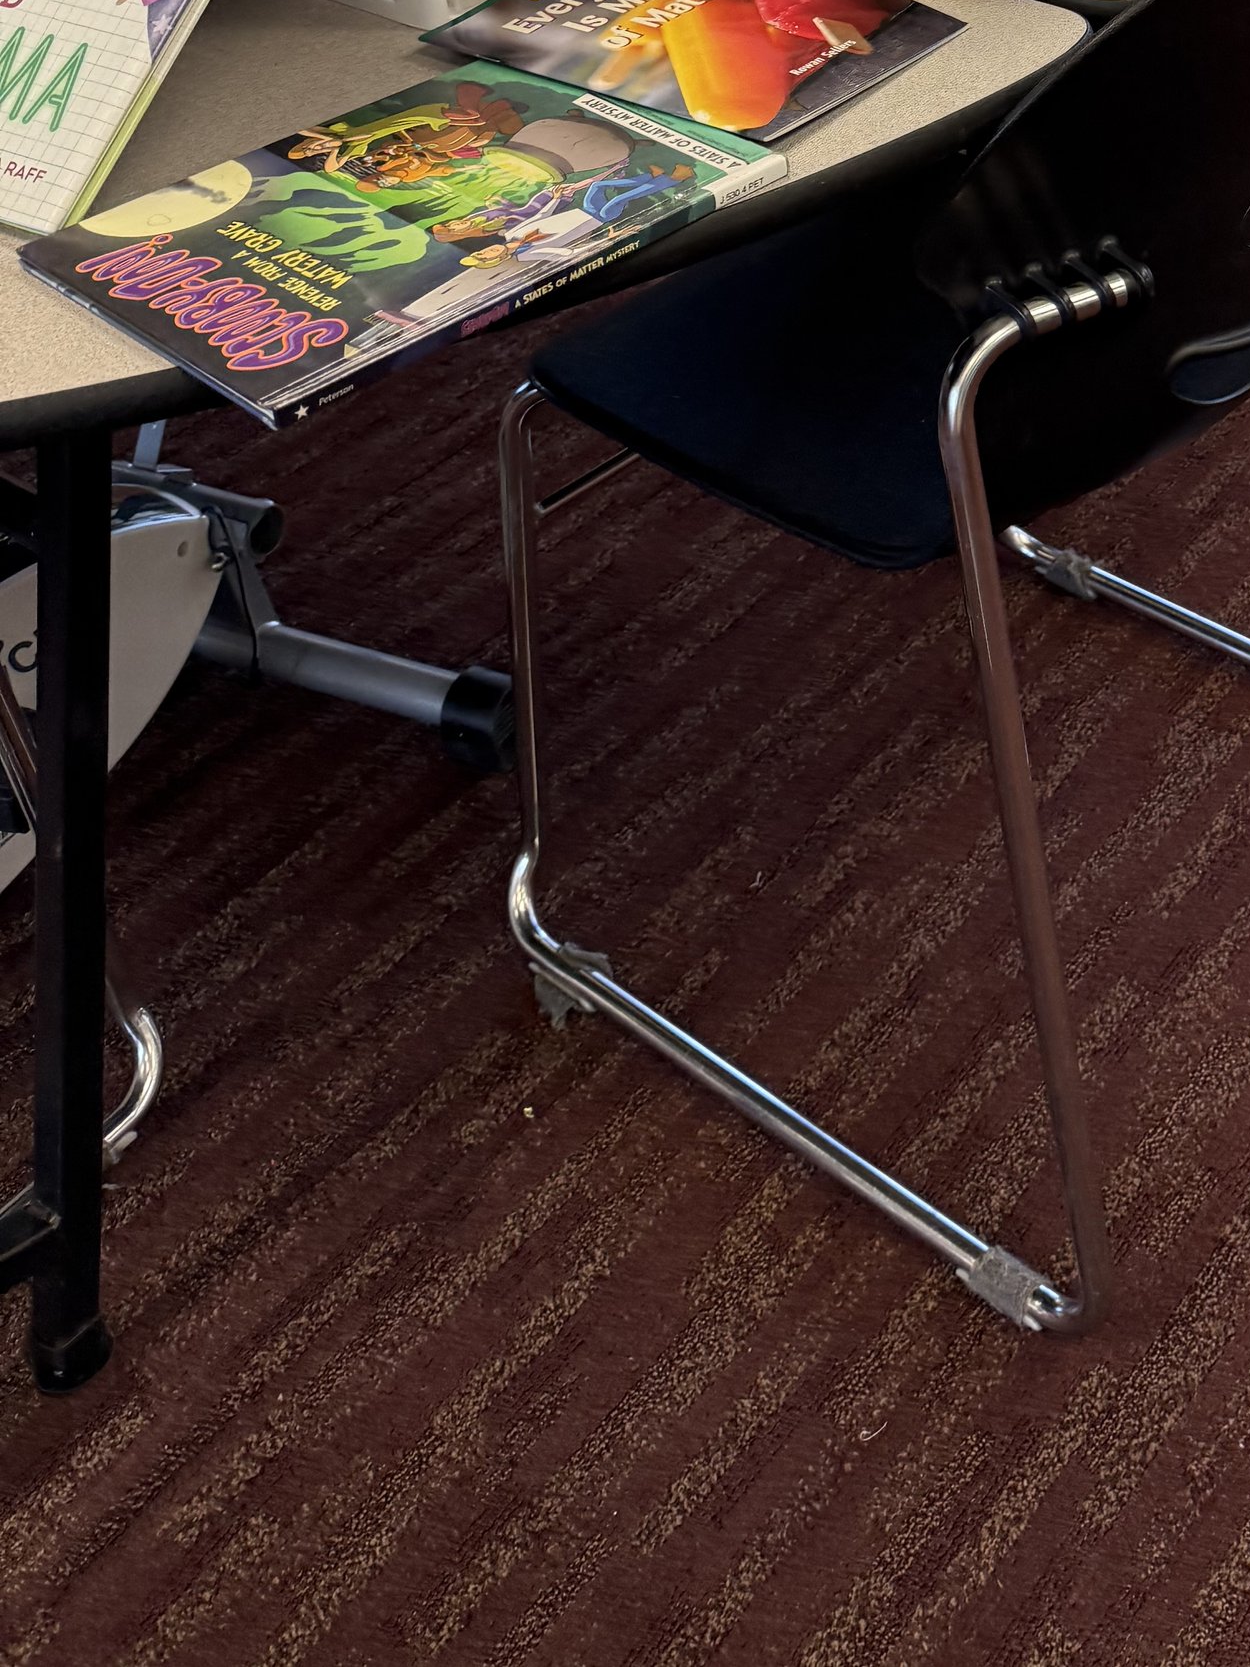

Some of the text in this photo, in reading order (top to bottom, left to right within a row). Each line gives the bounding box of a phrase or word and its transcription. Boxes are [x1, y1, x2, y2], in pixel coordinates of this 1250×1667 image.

[562, 14, 609, 33] Is
[601, 24, 644, 51] of
[789, 40, 857, 76] Rowan Sellers
[581, 98, 634, 122] MYSTERY
[629, 119, 671, 139] MATTER
[668, 137, 691, 148] OF
[689, 145, 730, 165] STATES
[727, 160, 742, 169] A
[5, 160, 48, 184] RAFF
[748, 177, 765, 192] PET
[216, 220, 354, 291] WATERY GRAVE
[231, 249, 343, 312] REVENGE FROM A
[513, 239, 641, 310] A STATES OF MATTER MYSTERY
[318, 384, 354, 406] Peterson
